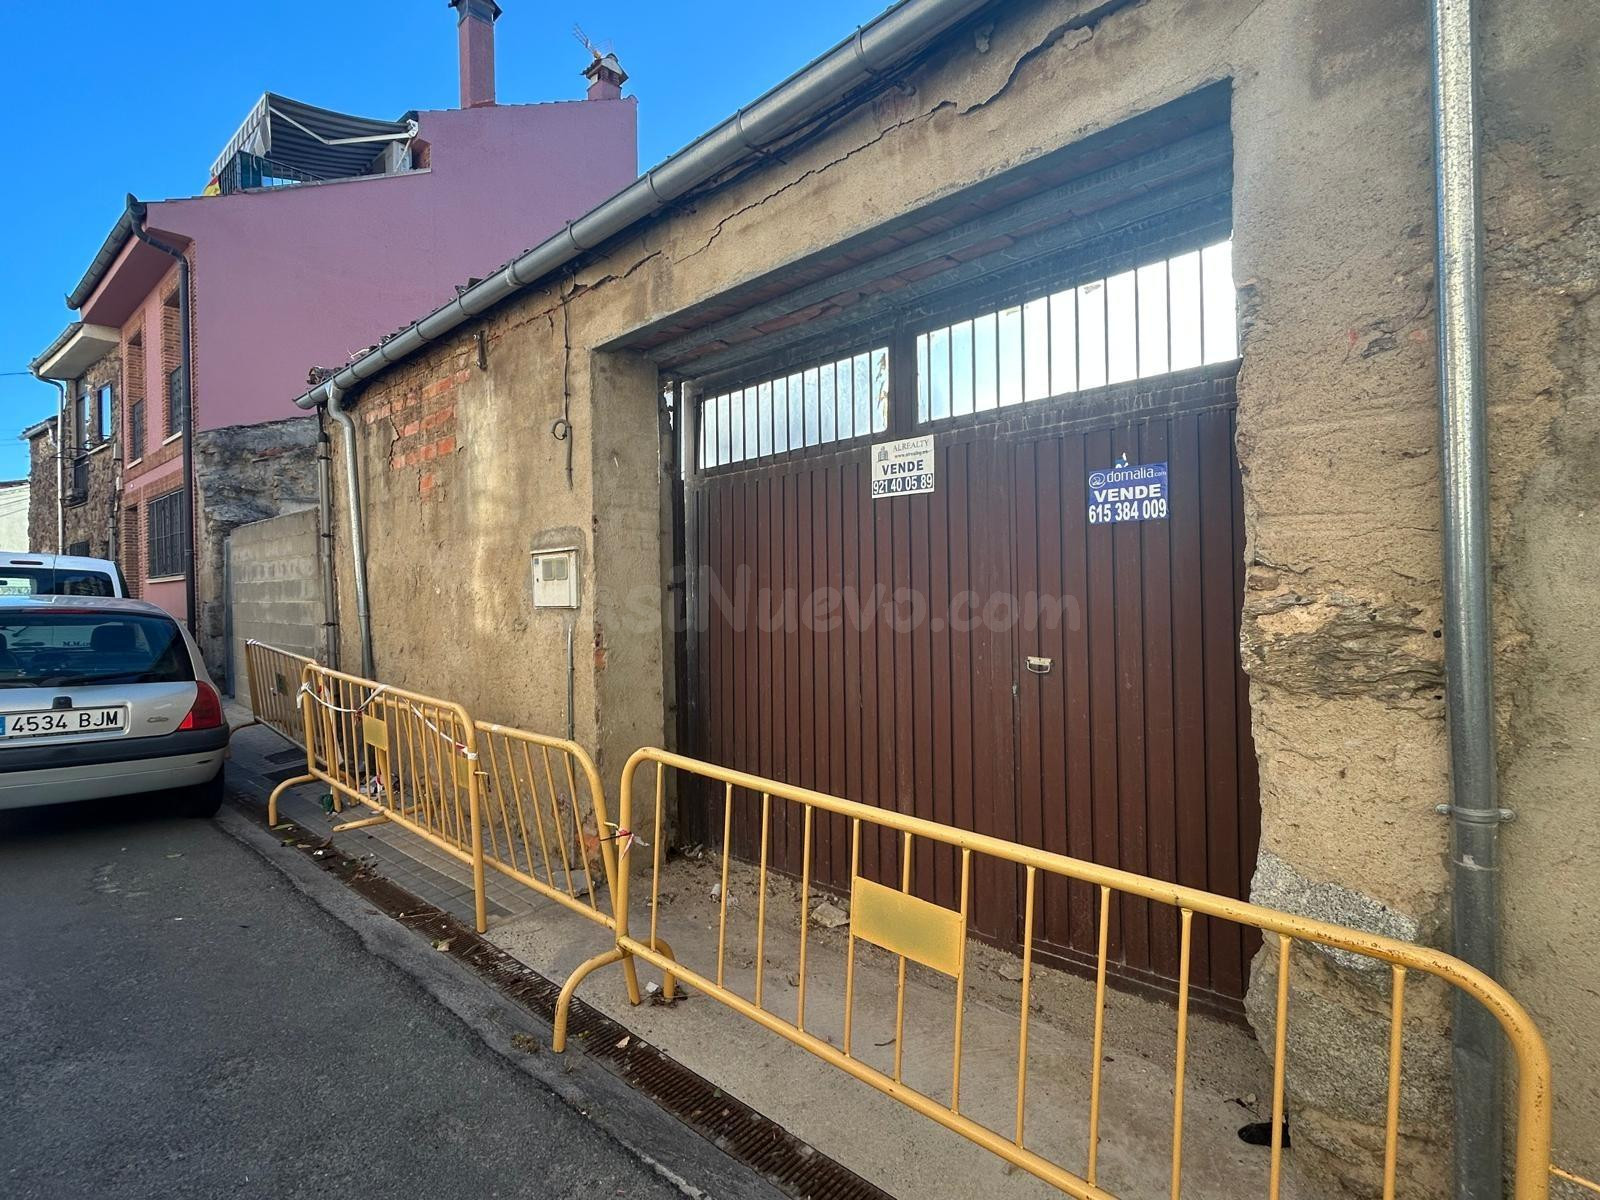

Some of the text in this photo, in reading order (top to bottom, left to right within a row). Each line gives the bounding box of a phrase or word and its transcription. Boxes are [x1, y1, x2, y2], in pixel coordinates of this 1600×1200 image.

[893, 439, 929, 452] ALREALTY
[881, 459, 924, 476] VENDE
[873, 474, 933, 495] 921 40 05 89
[1093, 484, 1161, 503] VENDE
[1088, 498, 1167, 524] 615 384 009
[11, 710, 118, 733] 4534 BJM
